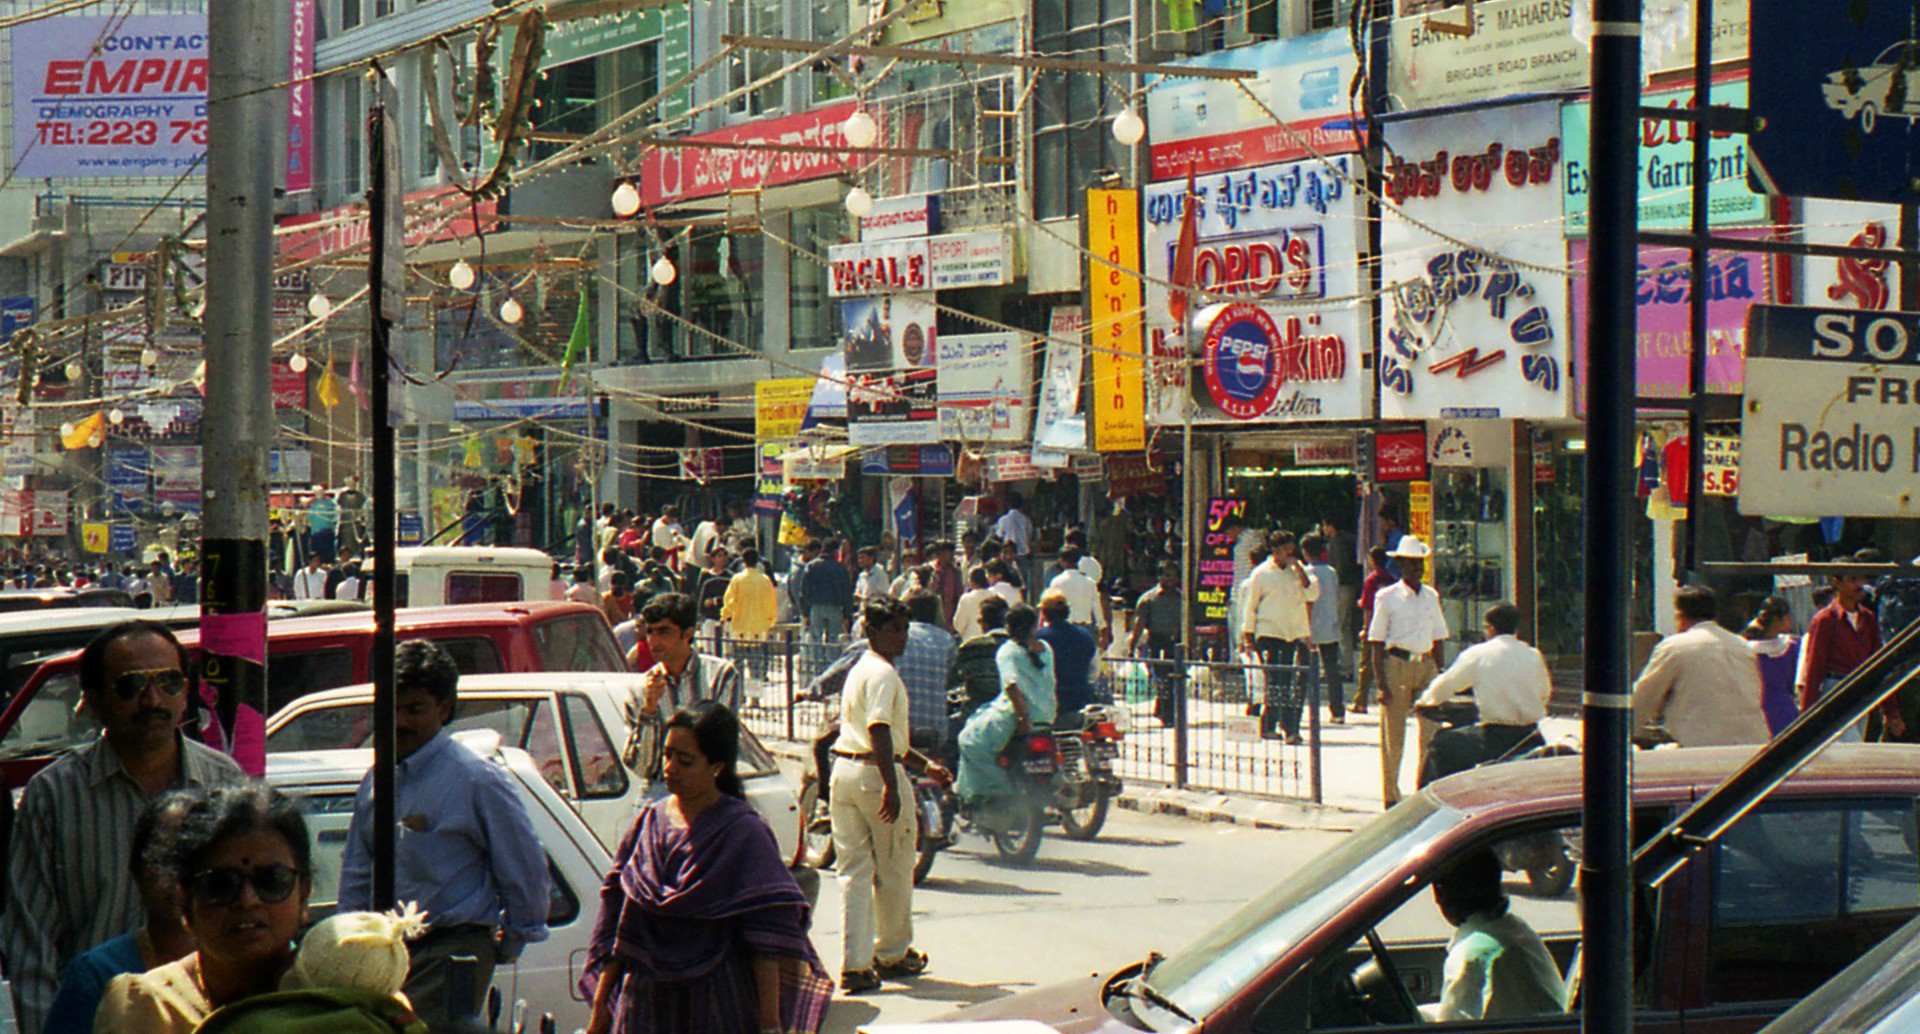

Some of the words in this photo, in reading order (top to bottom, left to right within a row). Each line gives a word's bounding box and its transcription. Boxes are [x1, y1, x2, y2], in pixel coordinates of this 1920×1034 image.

[104, 35, 208, 51] CONTAC
[44, 58, 208, 94] EMPIR
[1445, 63, 1493, 83] BRIGADE
[1497, 58, 1527, 73] ROAD
[1530, 49, 1577, 69] BRANCH
[40, 105, 175, 119] DEMOGRAPHY
[1194, 229, 1311, 296] ORD'S
[1220, 336, 1269, 361] PEPSI
[1813, 313, 1920, 361] SO
[1847, 375, 1920, 404] FR
[1779, 422, 1895, 474] Radio
[1379, 465, 1421, 475] SHOES
